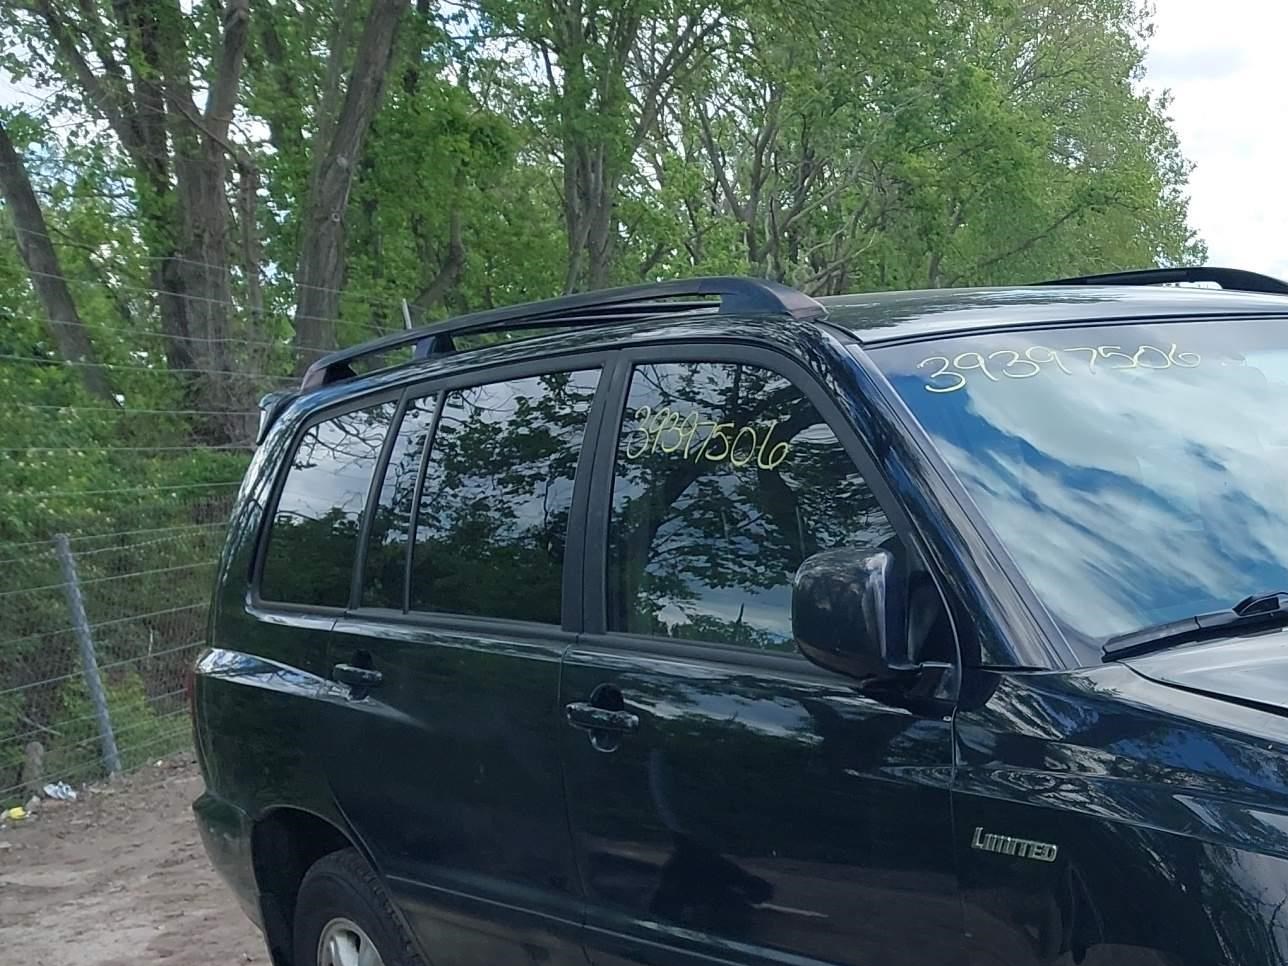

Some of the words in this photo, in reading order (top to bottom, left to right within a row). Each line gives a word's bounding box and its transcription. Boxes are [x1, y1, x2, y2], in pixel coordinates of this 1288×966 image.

[916, 343, 1201, 393] 39397506
[626, 405, 789, 470] 39397506
[971, 826, 1058, 862] LIMITED
